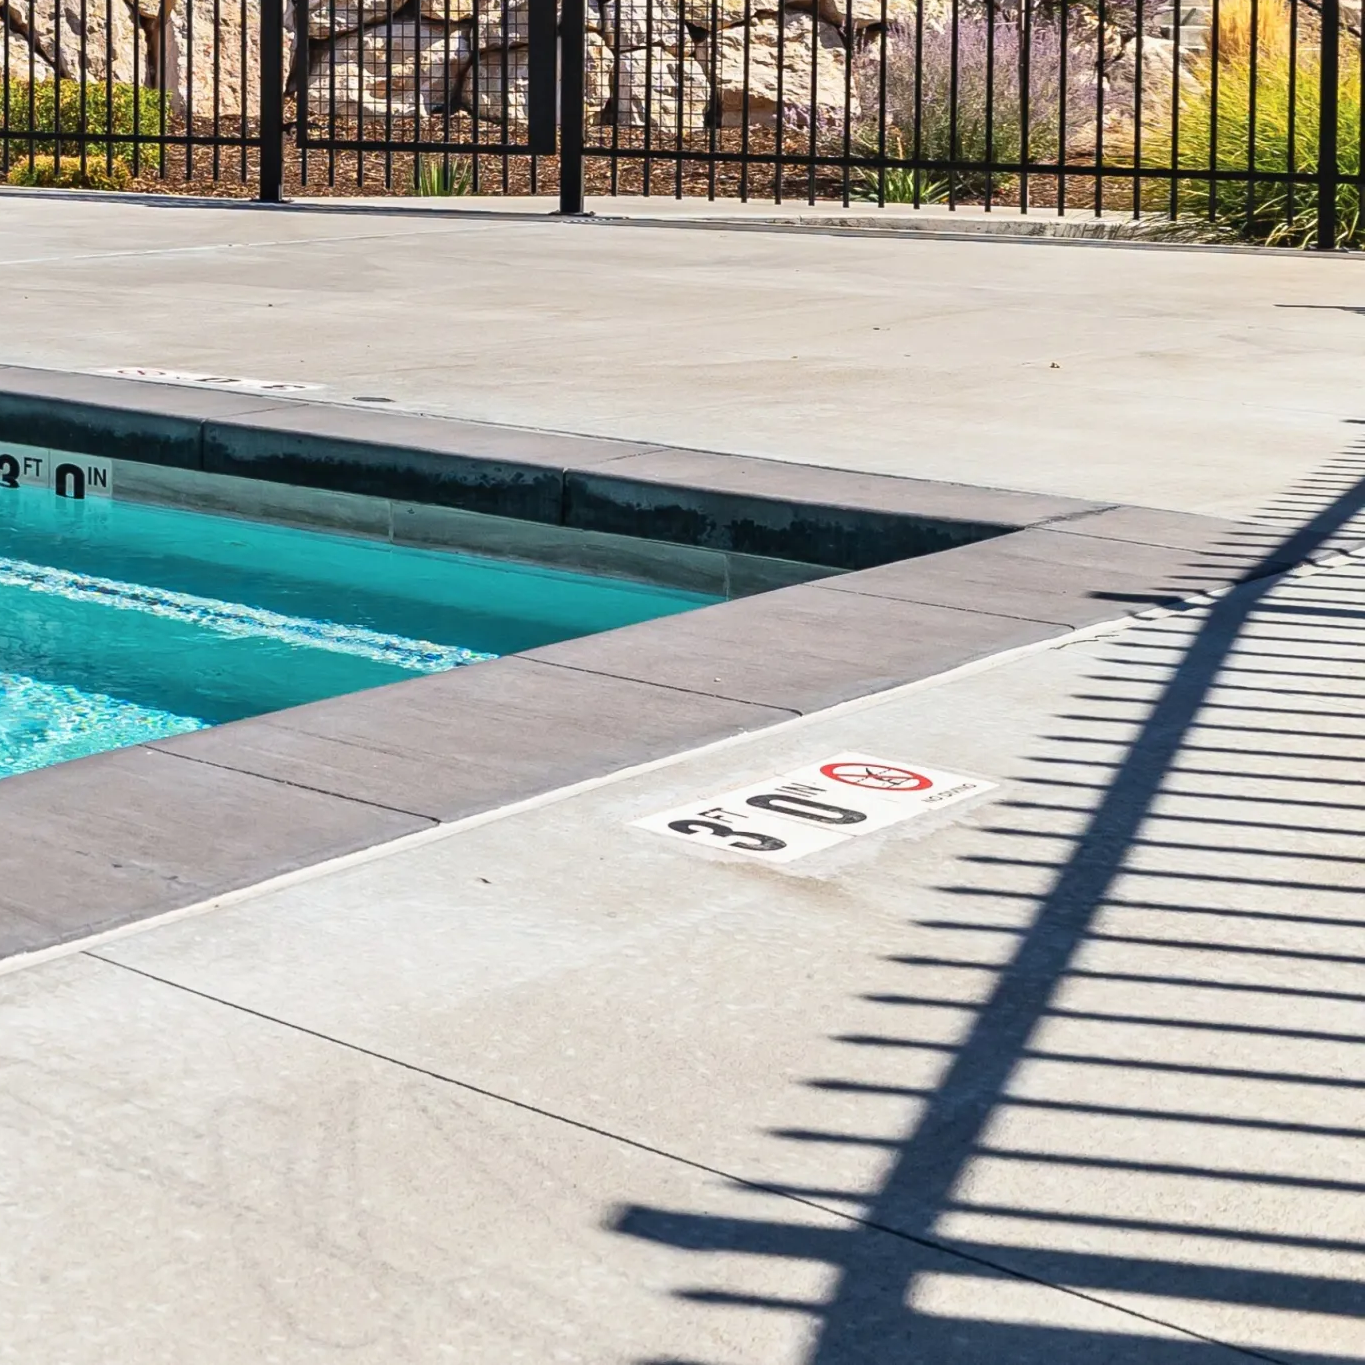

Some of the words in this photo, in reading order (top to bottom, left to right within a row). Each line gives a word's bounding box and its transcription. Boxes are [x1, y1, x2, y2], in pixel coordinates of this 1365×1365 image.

[24, 456, 43, 477] FT
[88, 466, 107, 488] IN
[668, 819, 787, 851] 3
[746, 794, 867, 825] 0
